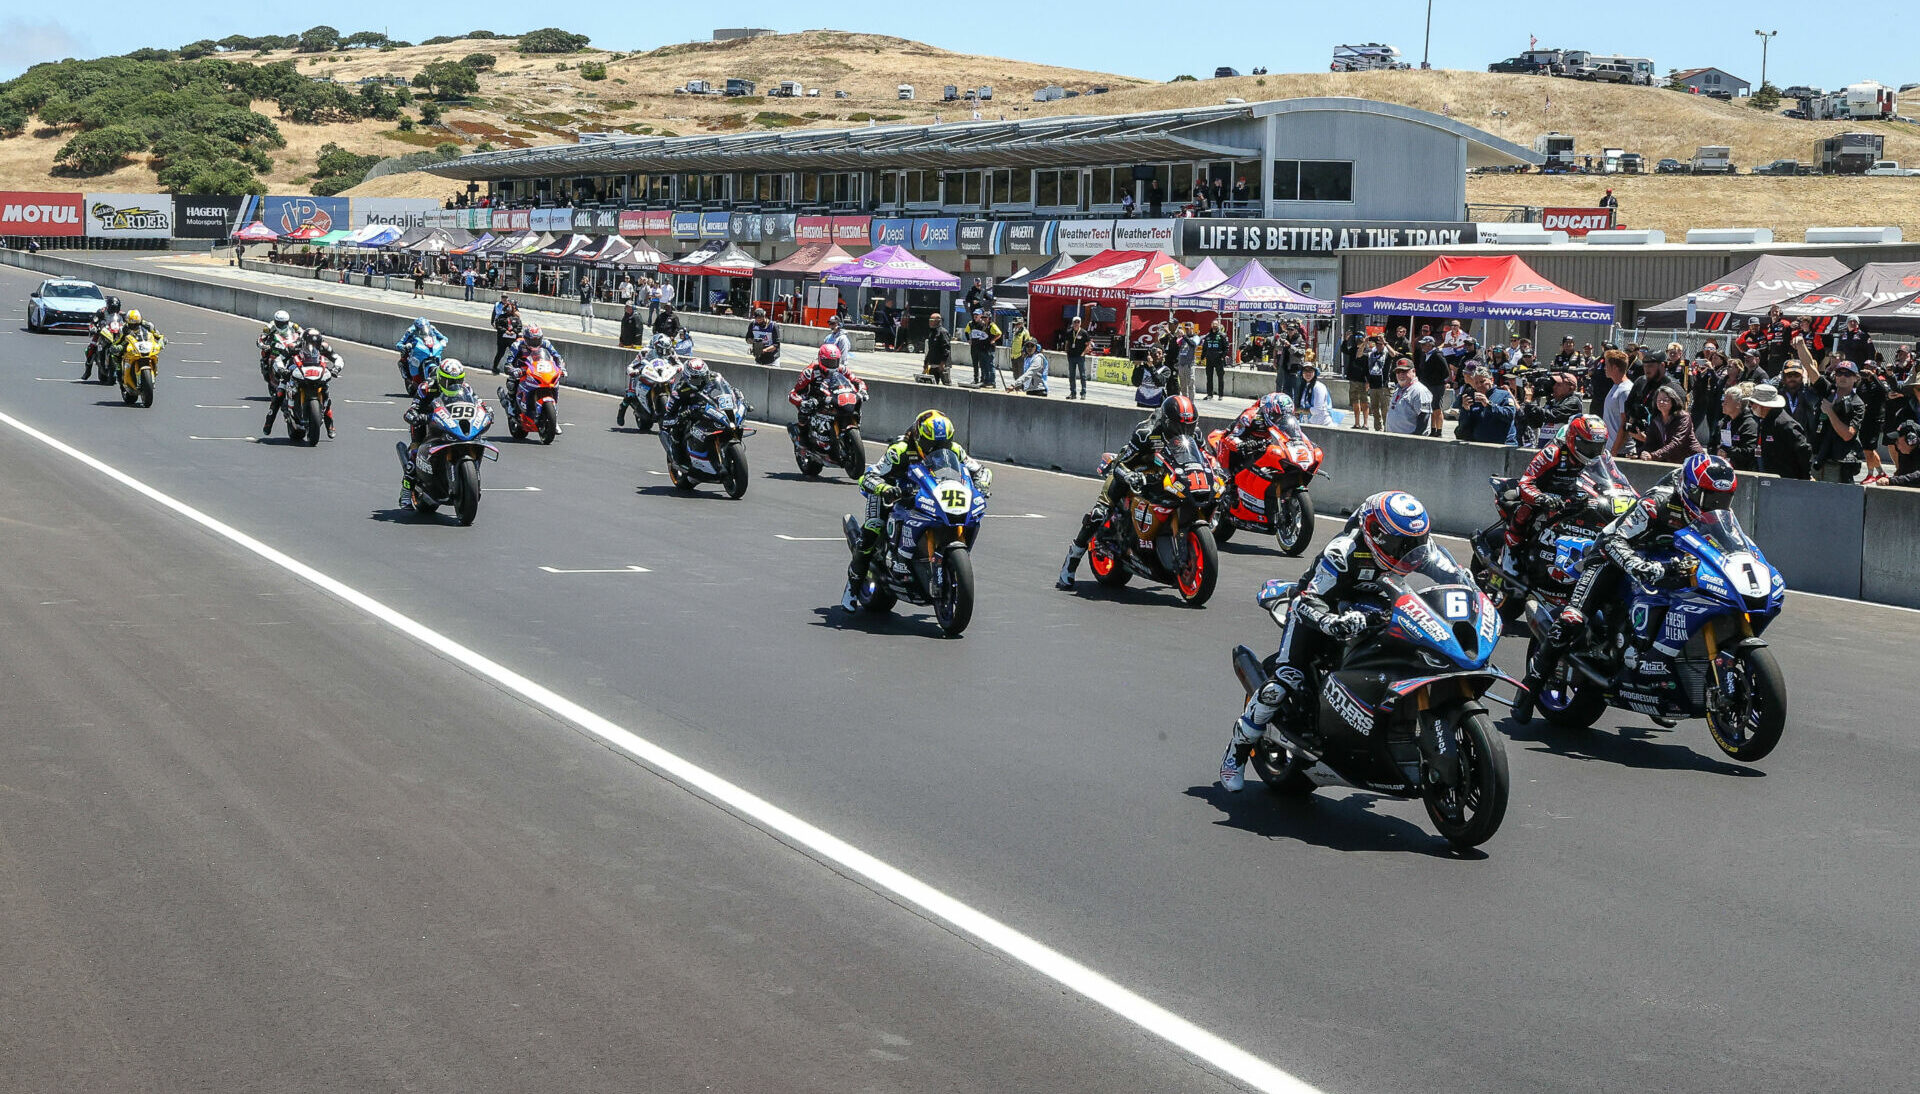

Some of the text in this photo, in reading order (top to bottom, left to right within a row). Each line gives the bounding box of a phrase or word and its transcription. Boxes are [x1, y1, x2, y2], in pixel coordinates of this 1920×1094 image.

[2, 204, 79, 224] MOTUL
[186, 207, 229, 217] HAGERTY
[102, 213, 168, 230] HARDER
[186, 218, 223, 227] Motorsports
[366, 213, 424, 228] Medallia
[1545, 215, 1607, 229] DUCATI
[886, 227, 905, 245] pepsi
[929, 225, 949, 244] pepsi
[962, 226, 984, 239] HAGERTY
[1010, 226, 1035, 239] HAGERTY
[1060, 228, 1111, 240] WeatherTech
[1117, 227, 1172, 239] WeatherTech
[1199, 225, 1461, 250] LIFE IS BETTER AT THE TRACK
[874, 277, 957, 288] altusmotorsports.com
[1032, 284, 1126, 300] INDIAN MOTORCYCLE RACING
[1239, 301, 1262, 309] MOTOR
[1285, 303, 1316, 312] ADDITIVES
[1373, 301, 1452, 313] WWW.4SRUSA.COM
[1487, 307, 1611, 321] WWW.4SRUSA.COM
[452, 406, 474, 418] 99
[1188, 472, 1209, 491] 11
[941, 490, 966, 507] 45
[1561, 522, 1600, 538] VISION
[1743, 563, 1760, 590] 1
[1706, 582, 1728, 596] YAMAHA
[1446, 592, 1468, 618] 6
[1400, 605, 1441, 643] CYCLE RACING
[1405, 598, 1451, 641] TYTLERS
[1665, 611, 1687, 629] FRESH
[1400, 616, 1423, 639] alpha
[1640, 660, 1671, 674] Attack
[1620, 689, 1660, 704] PROGRESSIVE
[1325, 679, 1374, 730] TYTLERS
[1629, 702, 1660, 716] YAMAHA
[1323, 688, 1370, 737] CYCLE RACING
